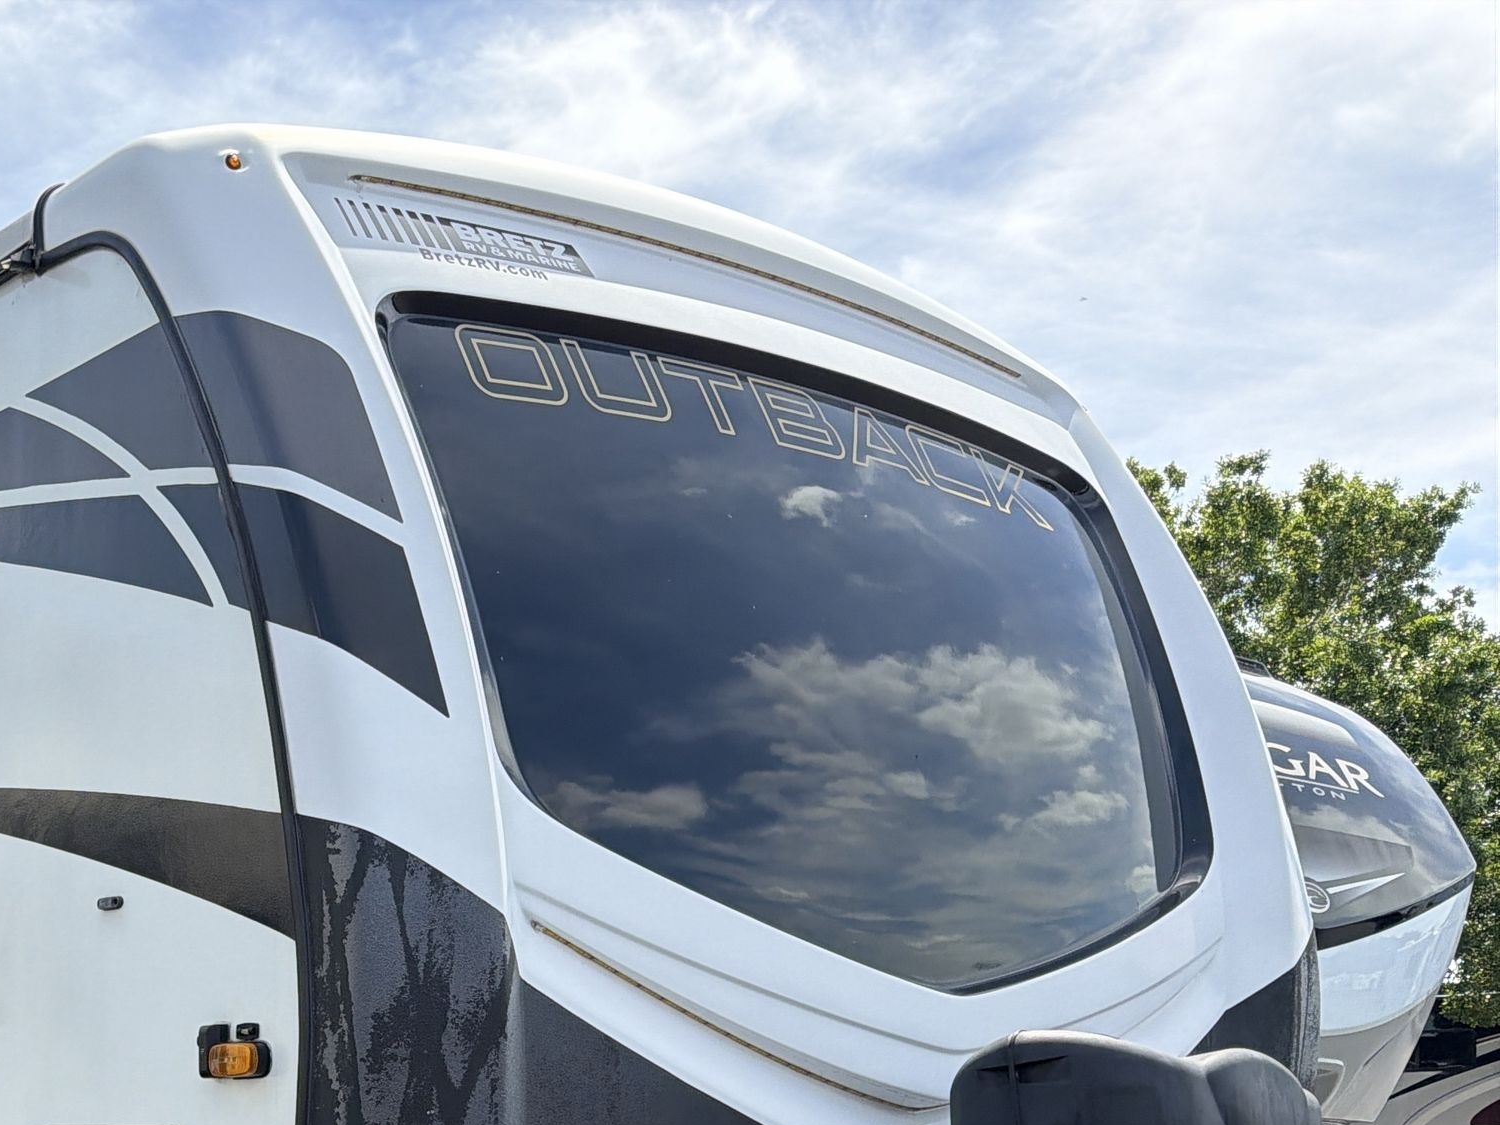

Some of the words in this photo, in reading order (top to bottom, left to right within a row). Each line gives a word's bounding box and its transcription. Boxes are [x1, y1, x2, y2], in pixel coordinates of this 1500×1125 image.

[450, 221, 575, 261] BRETZ
[419, 247, 548, 281] BretzRV.com
[454, 323, 1054, 531] OUTBACK
